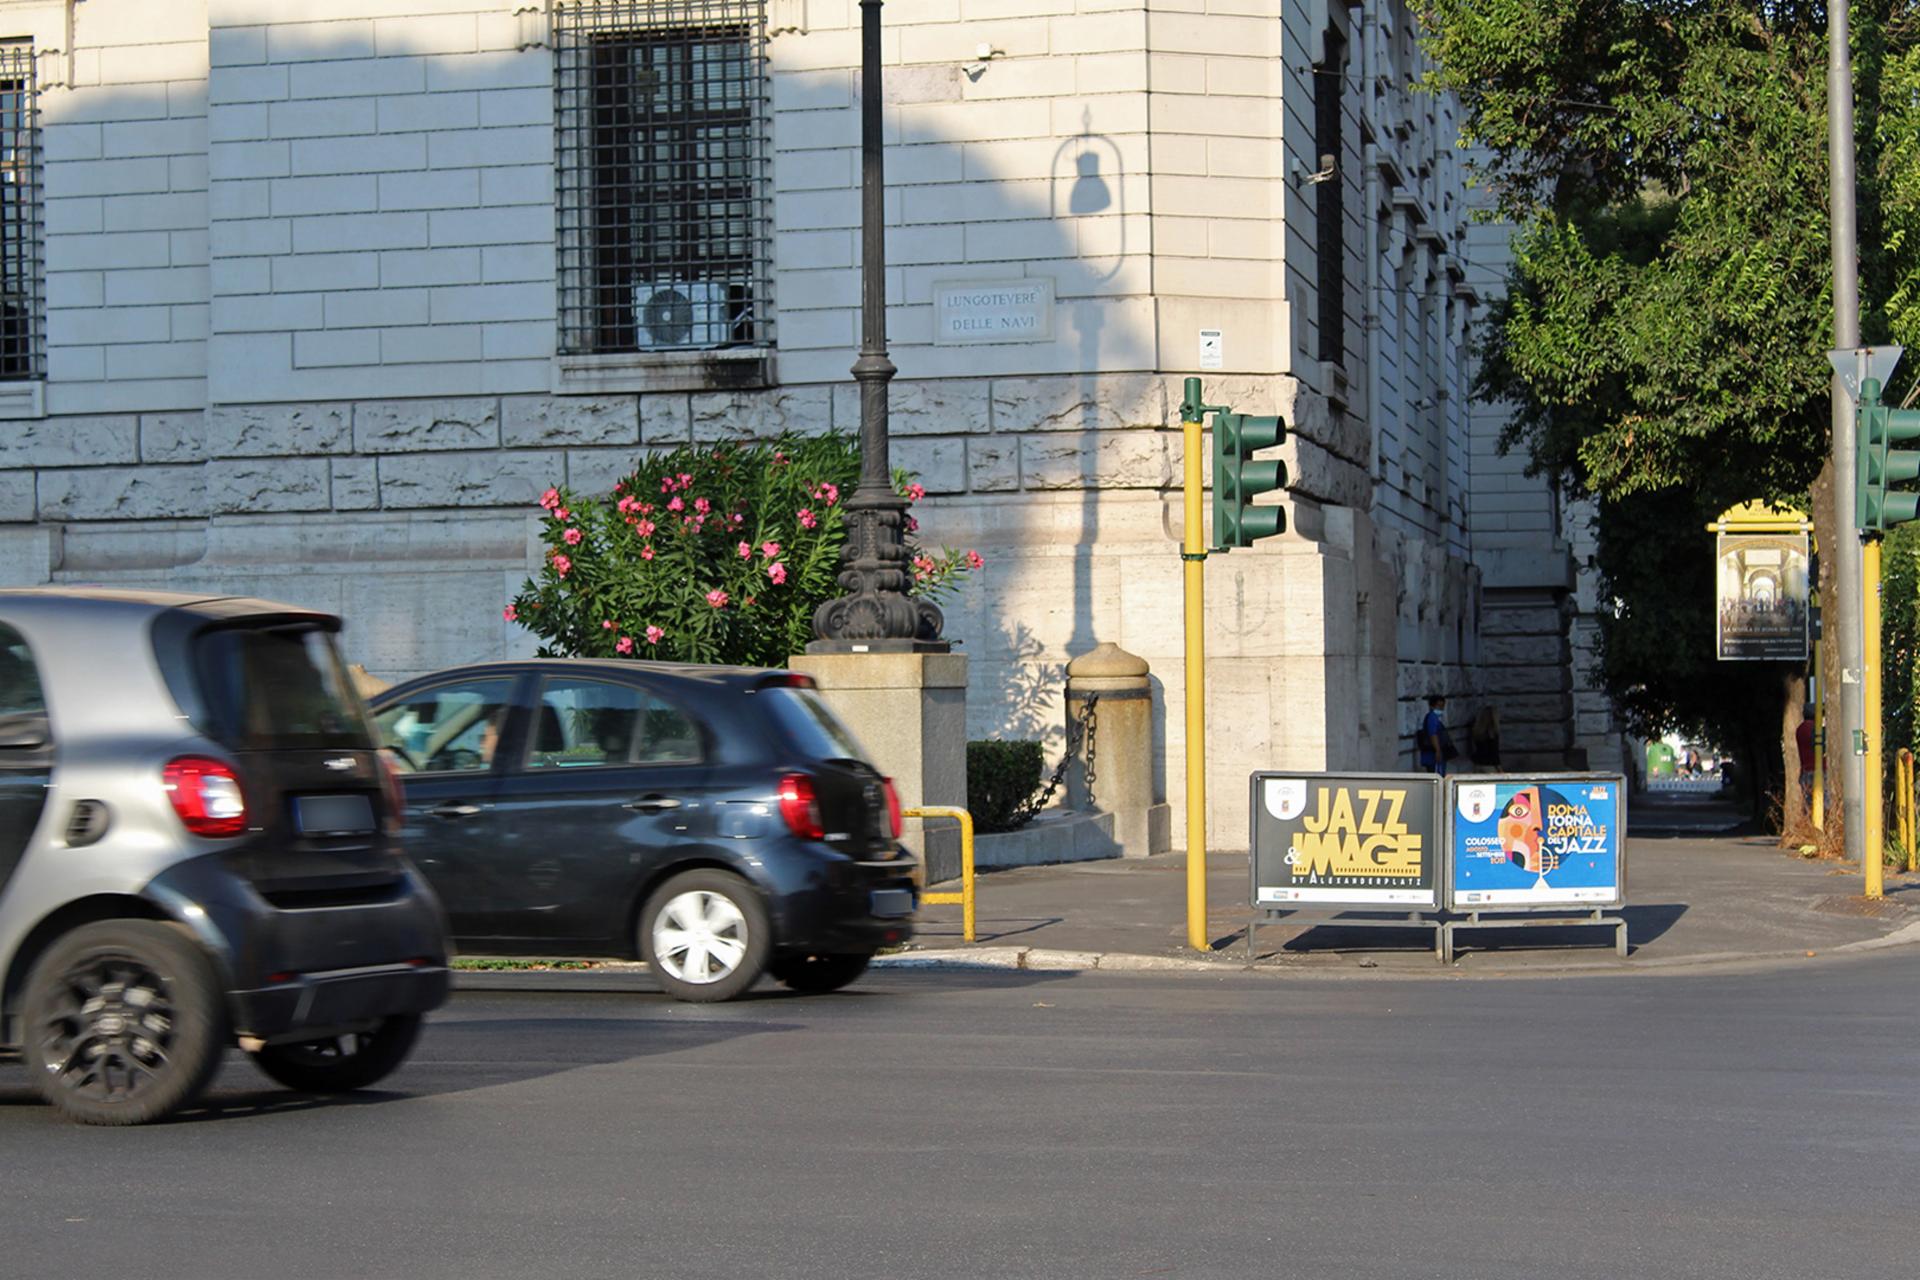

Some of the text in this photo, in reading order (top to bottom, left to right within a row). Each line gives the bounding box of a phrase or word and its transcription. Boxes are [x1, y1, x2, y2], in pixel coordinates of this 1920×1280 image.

[947, 293, 1036, 307] LUNGOTEVERE
[953, 316, 1034, 330] DELLE NAVI
[1303, 787, 1408, 834] JAZZ
[1548, 804, 1588, 816] ROMA
[1548, 815, 1593, 827] TORNA
[1548, 825, 1606, 837] CAPITALE
[1465, 837, 1506, 846] COLOSSEO
[1555, 837, 1607, 854] JAZZ
[1284, 832, 1422, 877] & IMAGE
[1309, 870, 1421, 886] ALEXANDERPLATZ
